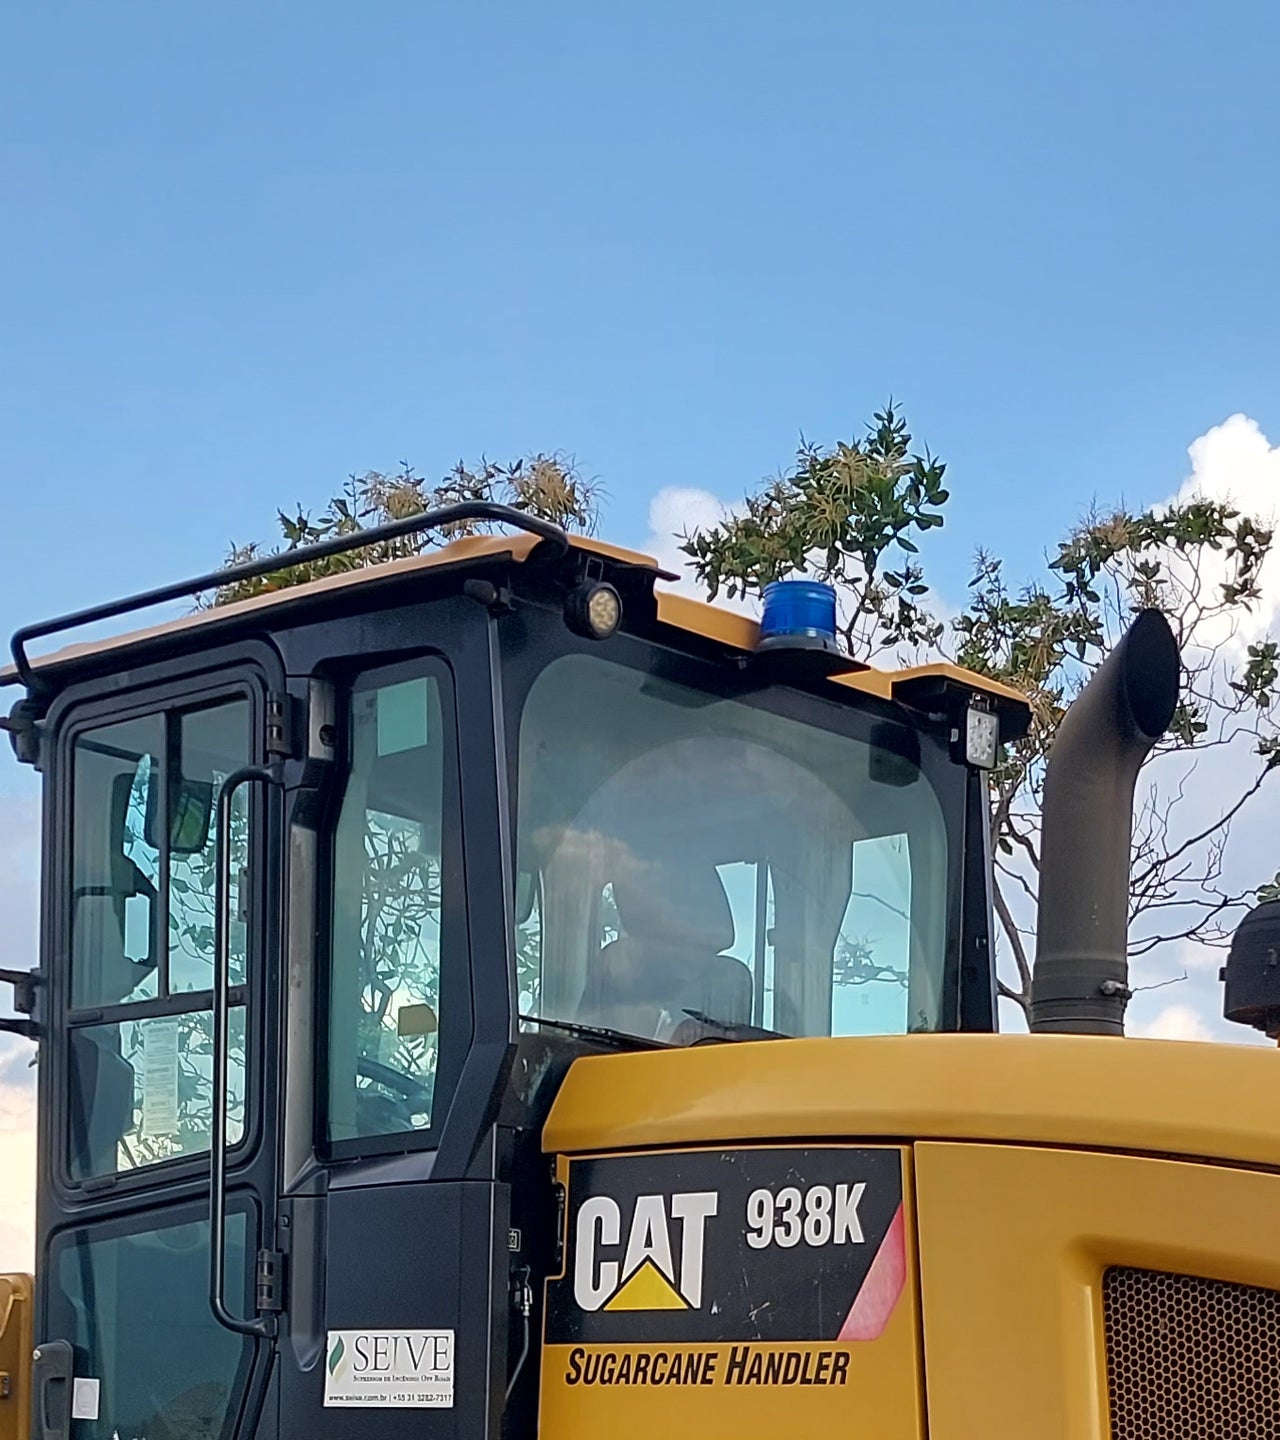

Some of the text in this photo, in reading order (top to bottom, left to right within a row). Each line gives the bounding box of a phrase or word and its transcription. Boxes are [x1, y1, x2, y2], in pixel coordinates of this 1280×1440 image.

[574, 1182, 867, 1312] CAT 938K
[353, 1335, 451, 1372] SEIVE
[565, 1346, 851, 1386] SUGARCANE HANDLER
